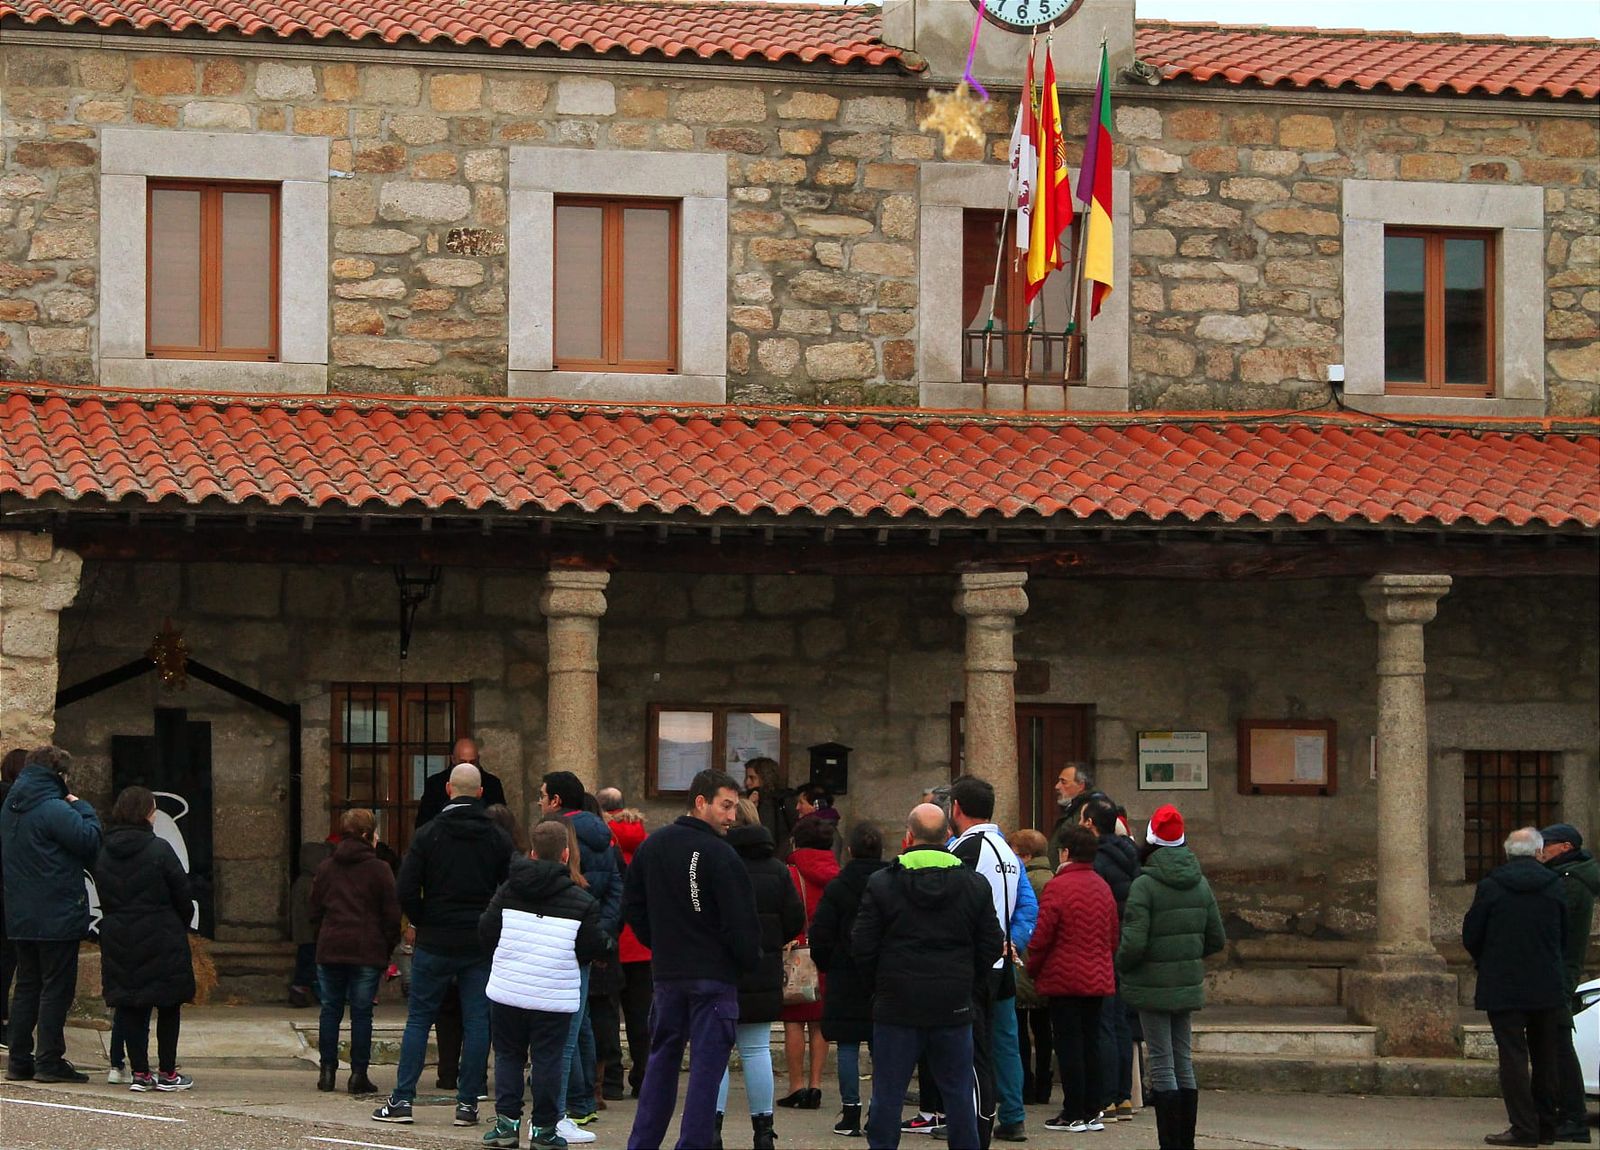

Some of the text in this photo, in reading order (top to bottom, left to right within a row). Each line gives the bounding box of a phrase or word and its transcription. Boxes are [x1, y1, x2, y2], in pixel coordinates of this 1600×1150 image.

[998, 0, 1006, 11] 7
[1017, 5, 1027, 19] 6
[1040, 0, 1050, 14] 5
